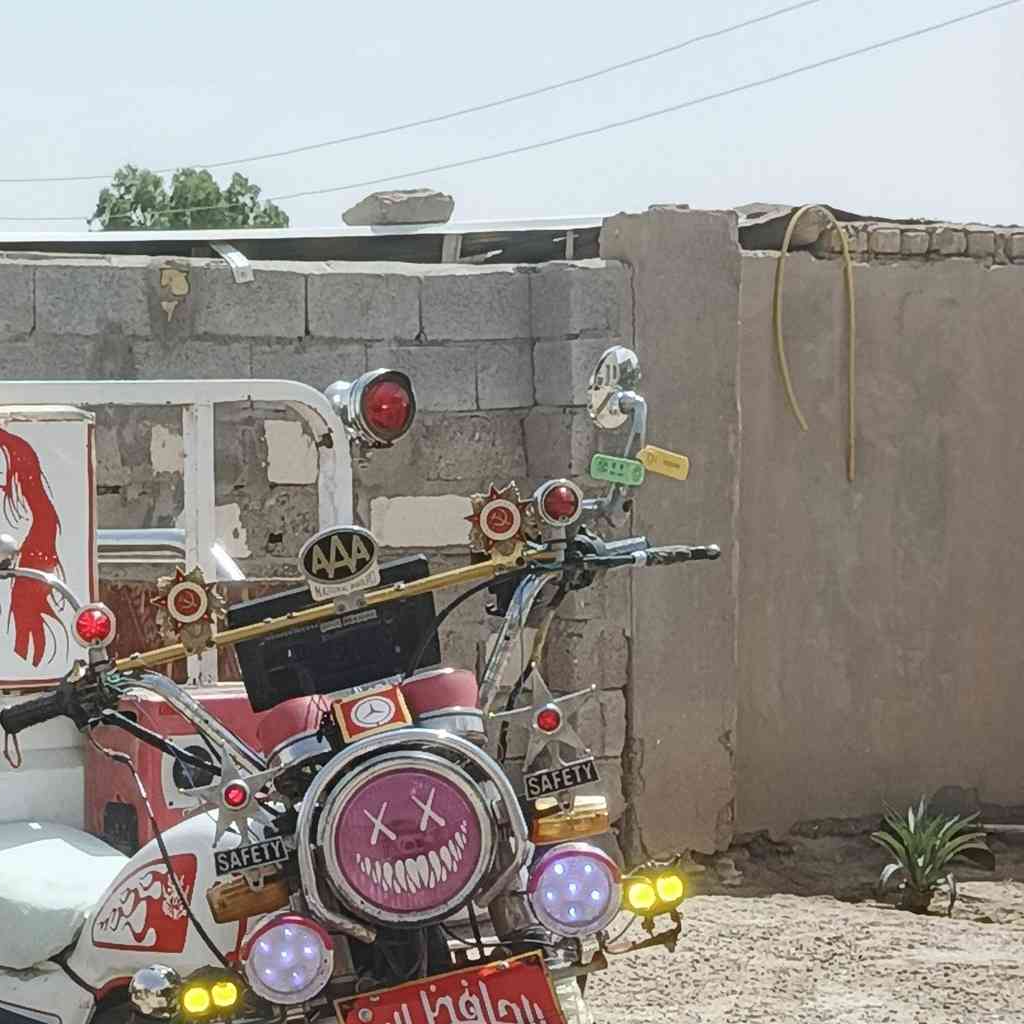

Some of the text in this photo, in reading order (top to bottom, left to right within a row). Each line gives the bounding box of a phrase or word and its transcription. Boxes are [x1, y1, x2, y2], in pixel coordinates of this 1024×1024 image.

[311, 534, 370, 579] AAA
[527, 762, 593, 796] SAFETY
[217, 840, 281, 872] SAFETY
